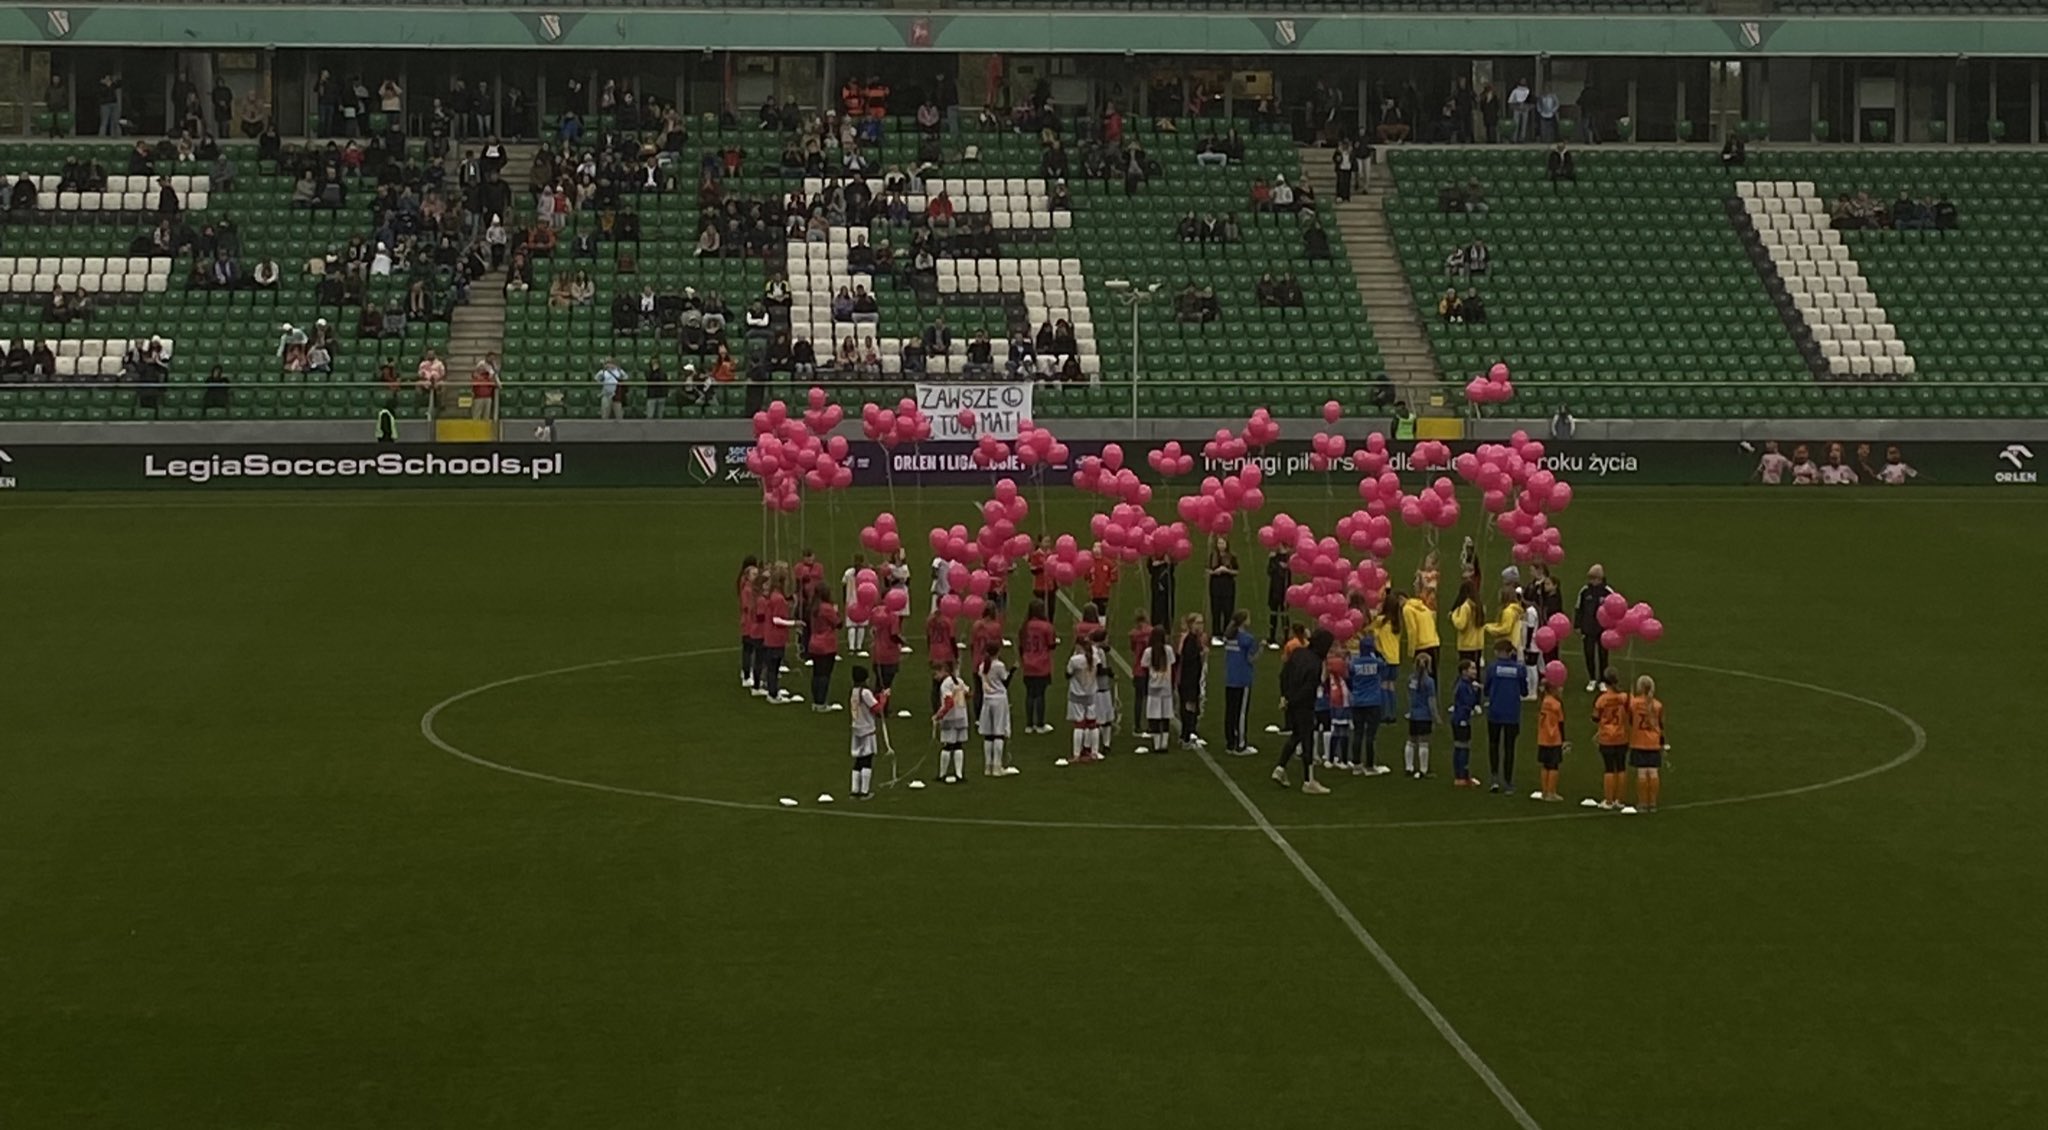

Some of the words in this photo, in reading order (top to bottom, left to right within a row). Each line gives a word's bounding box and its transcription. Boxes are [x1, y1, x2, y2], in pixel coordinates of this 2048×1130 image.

[919, 388, 998, 410] ZAWSZE
[145, 453, 562, 482] LegiaSoccerSchools.pl
[893, 454, 936, 471] ORLEN
[939, 455, 945, 471] 1
[947, 454, 978, 471] LIGA
[1199, 452, 1281, 477] Treningi
[1537, 452, 1583, 471] roku
[1588, 452, 1638, 477] życia
[1994, 471, 2038, 483] ORLEN
